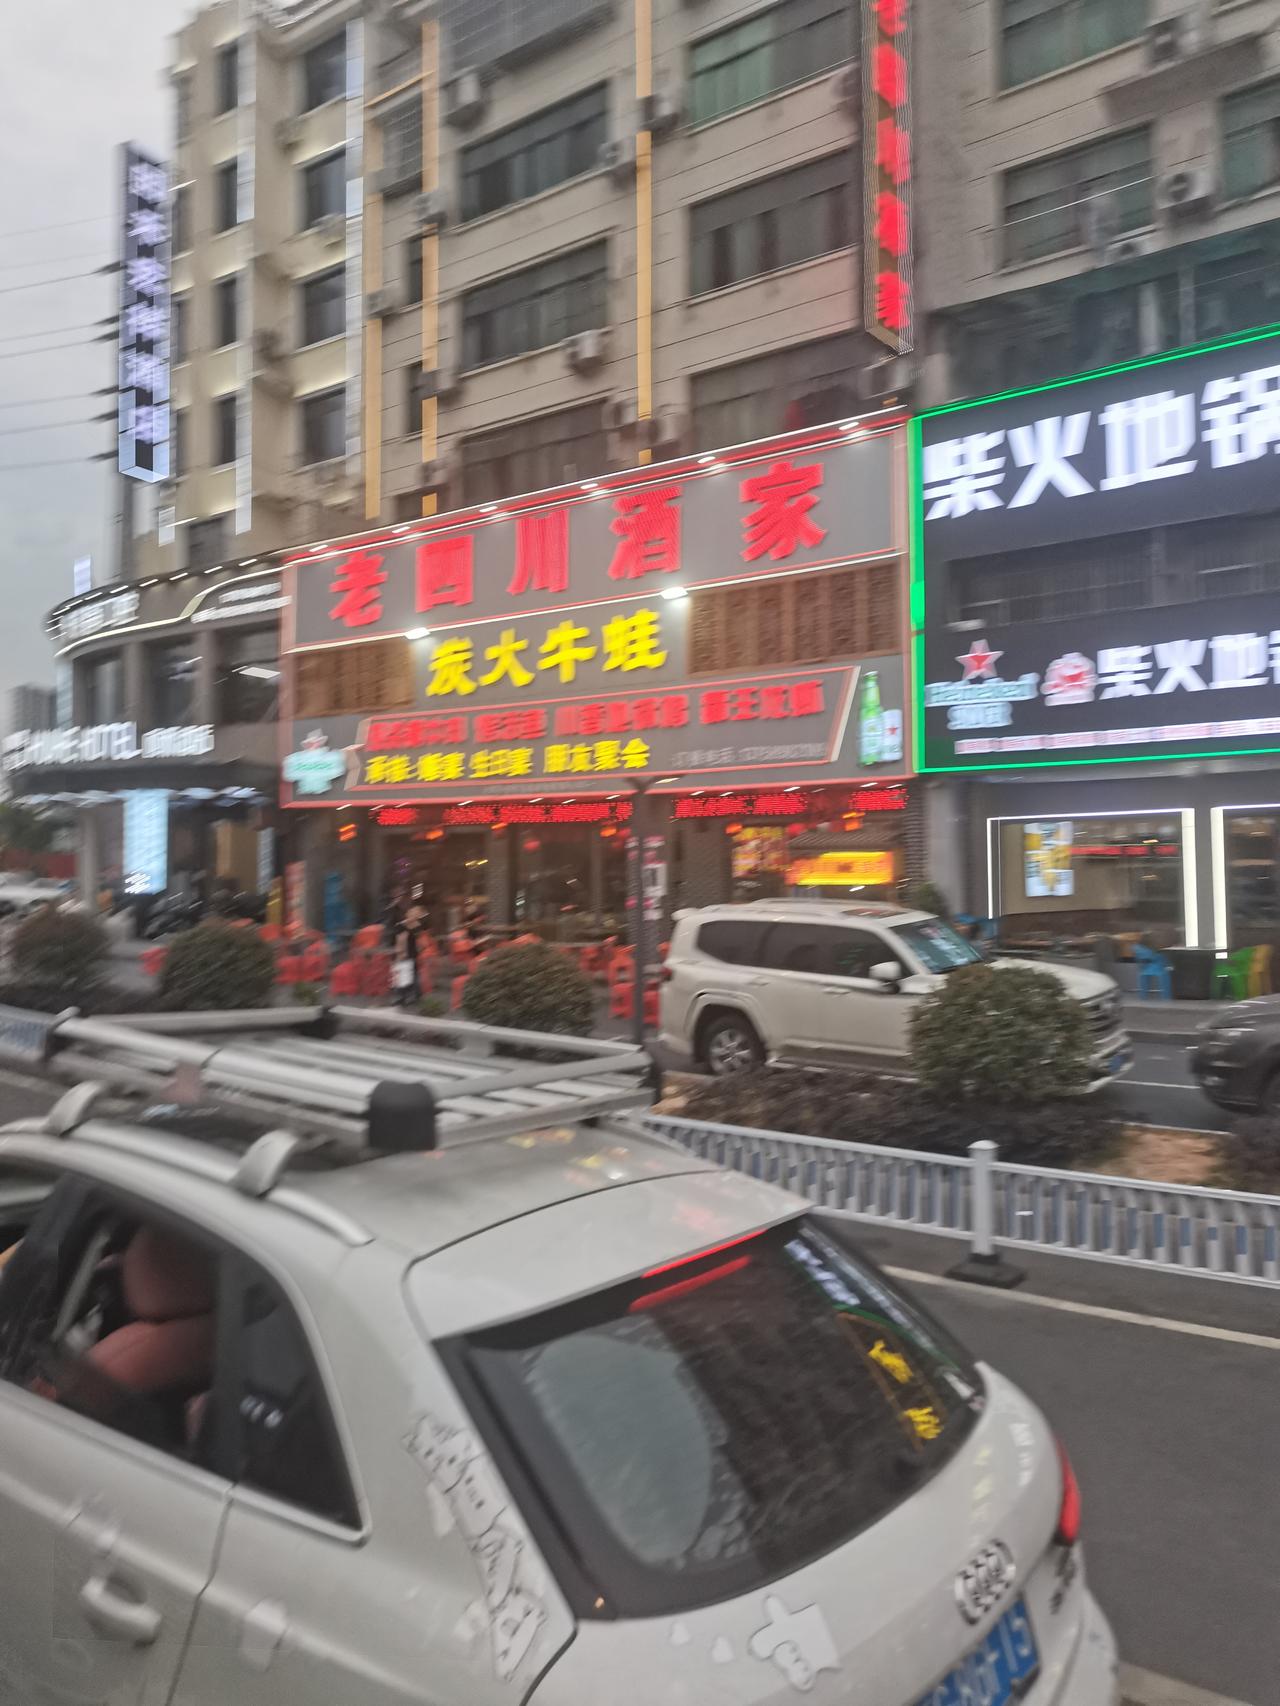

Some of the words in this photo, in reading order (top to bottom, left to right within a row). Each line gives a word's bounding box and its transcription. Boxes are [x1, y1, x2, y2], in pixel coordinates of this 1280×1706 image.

[328, 460, 827, 629] 老四川酒家
[1096, 629, 1280, 700] 柴火地
